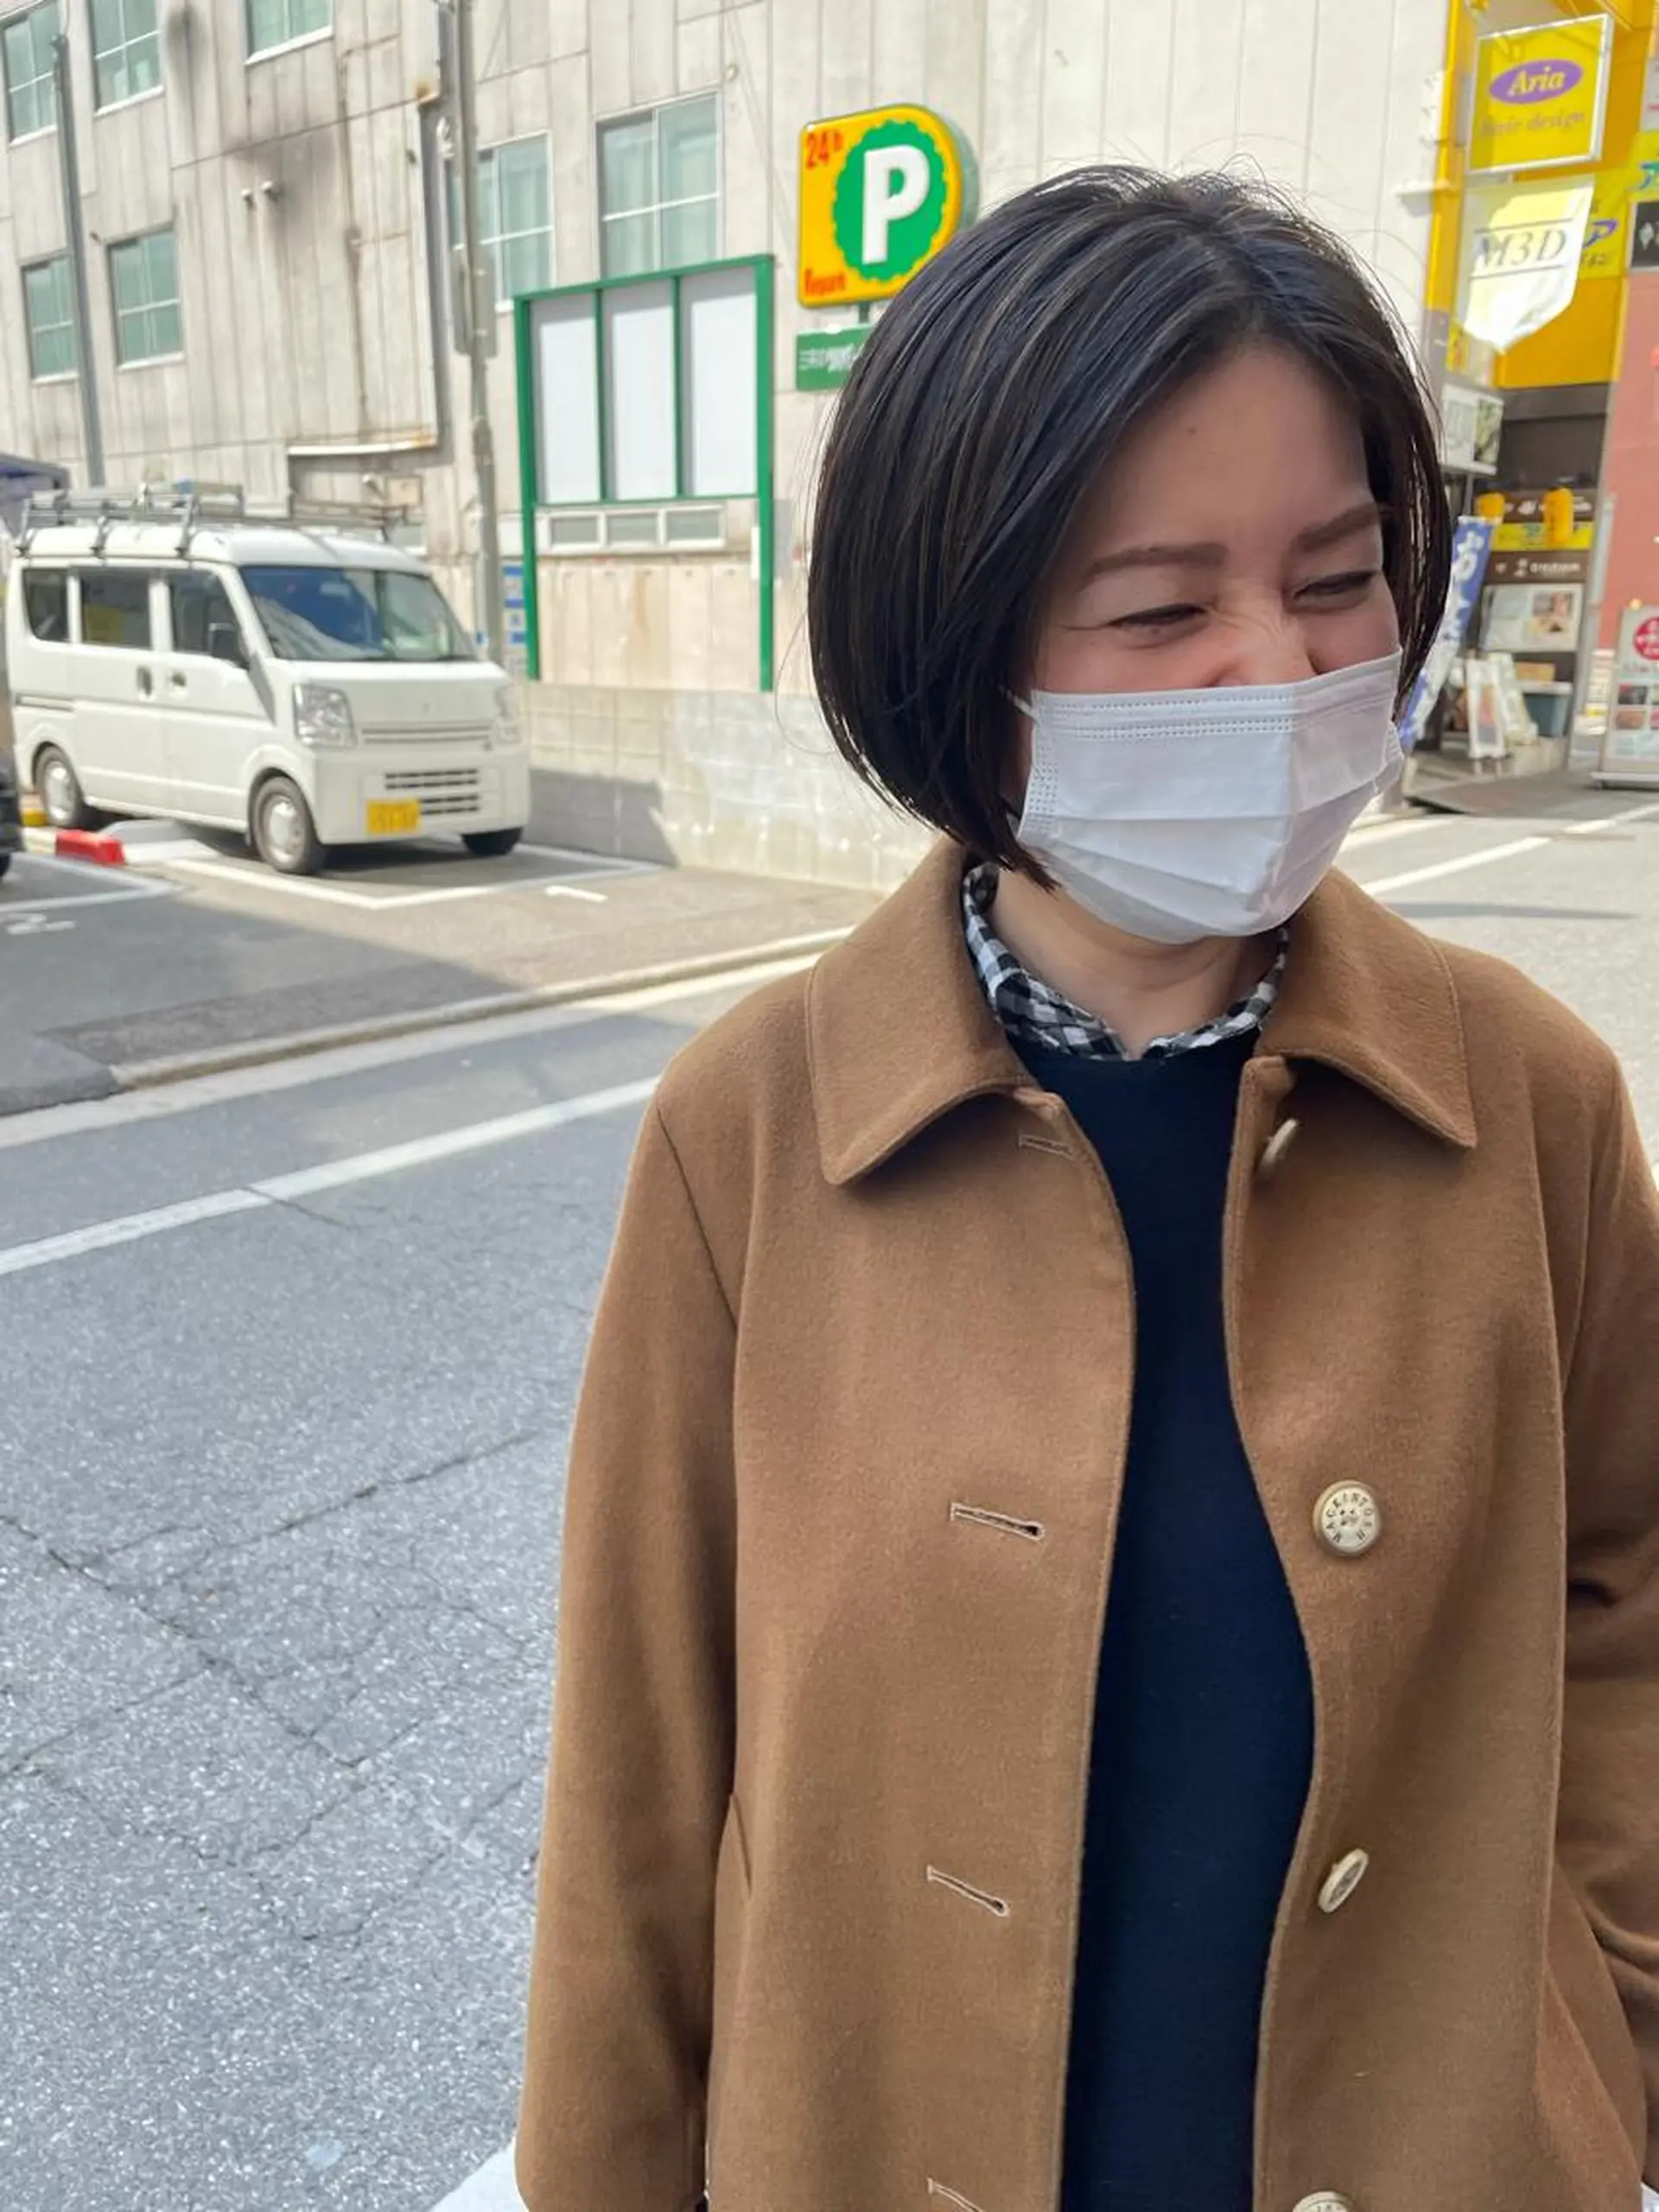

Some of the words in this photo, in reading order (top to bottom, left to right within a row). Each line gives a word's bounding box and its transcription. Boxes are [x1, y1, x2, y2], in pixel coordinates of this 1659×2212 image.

[1507, 65, 1566, 97] Aria
[1526, 109, 1585, 132] design
[862, 144, 931, 264] P
[1474, 228, 1567, 267] M3D
